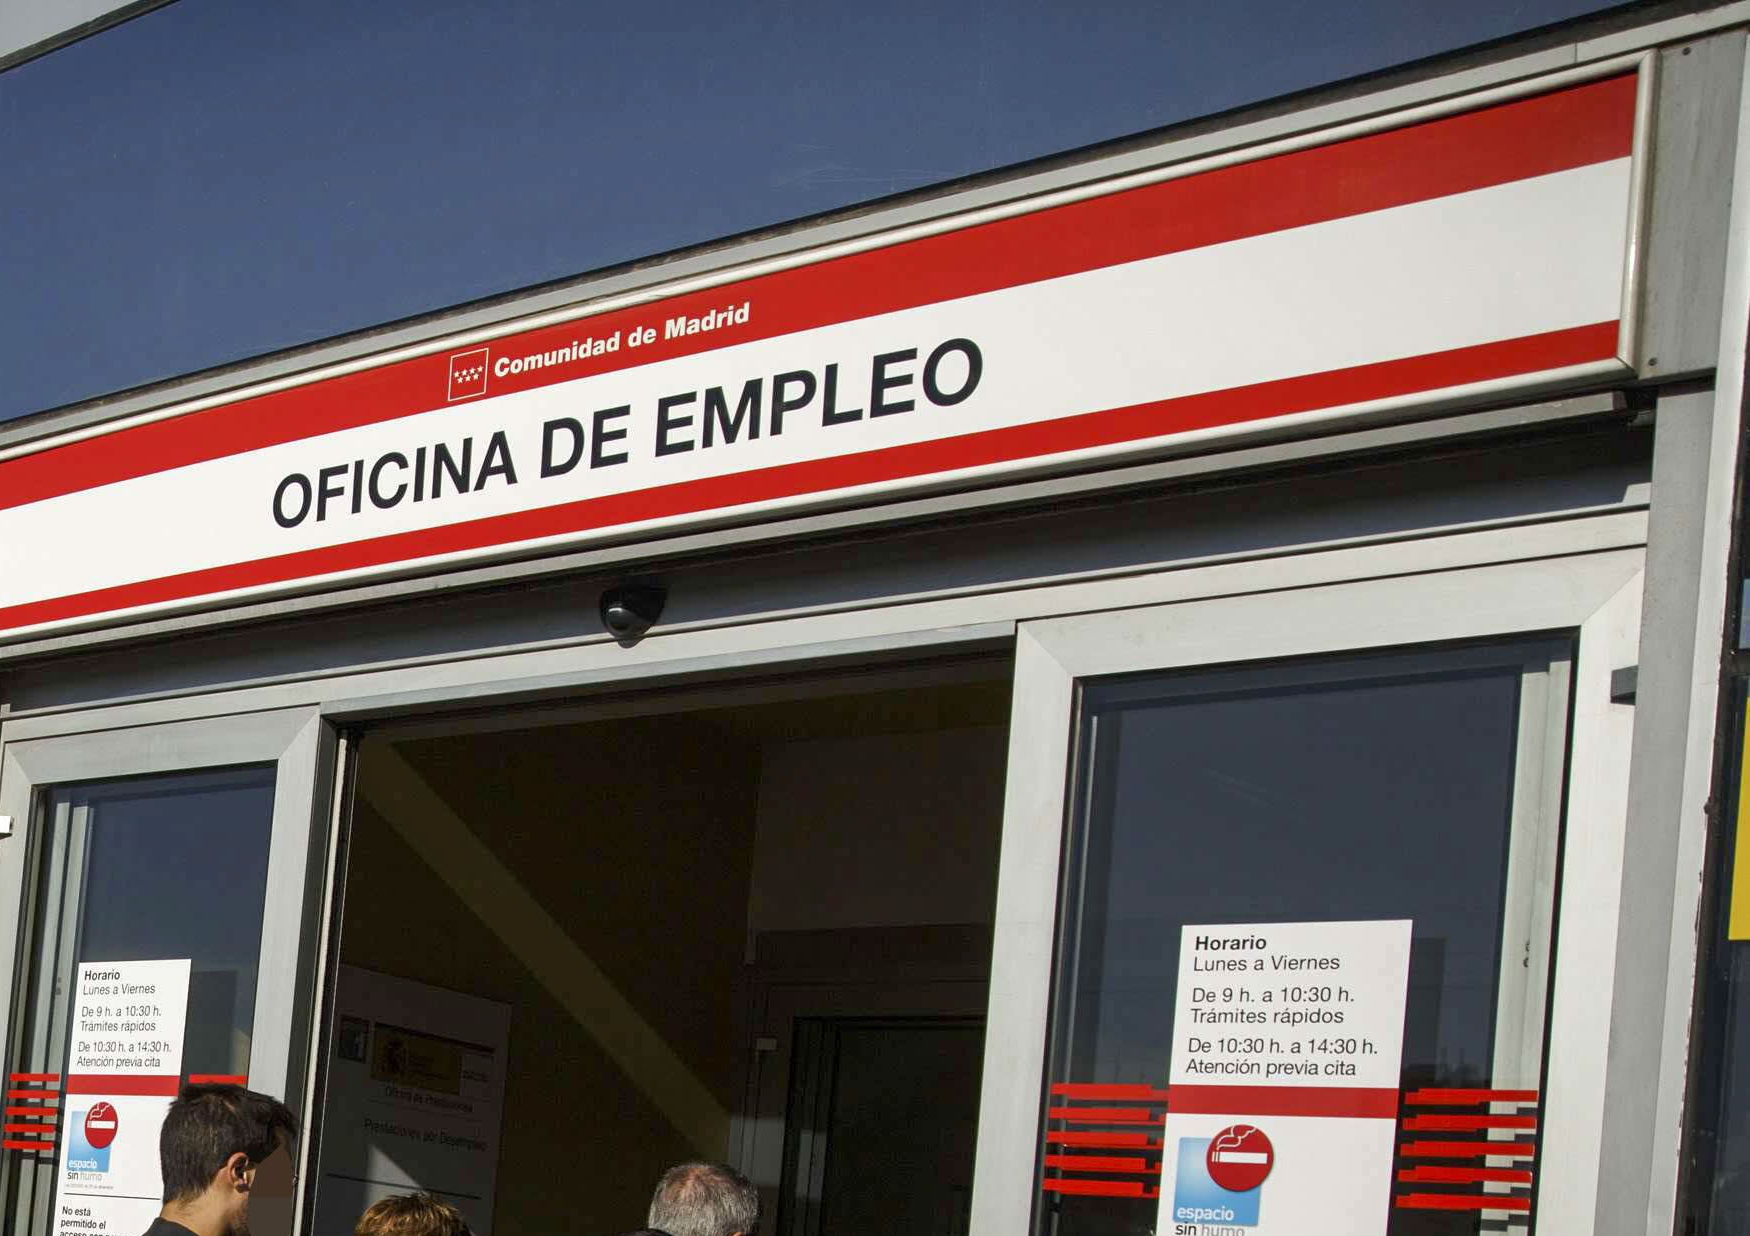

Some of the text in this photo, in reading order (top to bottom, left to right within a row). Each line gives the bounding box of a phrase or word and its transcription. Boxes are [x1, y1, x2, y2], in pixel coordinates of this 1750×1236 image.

[494, 302, 751, 379] Comunidad de Madrid
[271, 337, 985, 530] OFICINA DE EMPLEO
[1195, 935, 1267, 950] Horario
[1194, 955, 1340, 971] Lunes a Viernes
[85, 969, 120, 980] Horario
[83, 984, 155, 995] Lunes a Viernes
[1192, 987, 1354, 1003] De 9 h. a 10:30 h.
[82, 1005, 161, 1017] De 9 h. a 10:30 h.
[1191, 1008, 1344, 1026] Trámites rápidos
[81, 1021, 156, 1033] Trámites rápidos
[78, 1041, 171, 1052] De 10:30 h. a 14:30 h.
[1189, 1038, 1378, 1054] De 10:30 h. a 14:30 h.
[77, 1056, 160, 1068] Atención previa cita
[1186, 1059, 1356, 1078] Atención previa cita
[69, 1158, 97, 1170] espacio
[67, 1169, 78, 1180] sin
[62, 1206, 72, 1215] No
[1177, 1205, 1234, 1222] espacio
[61, 1219, 106, 1229] permitido el
[1175, 1221, 1196, 1235] sin
